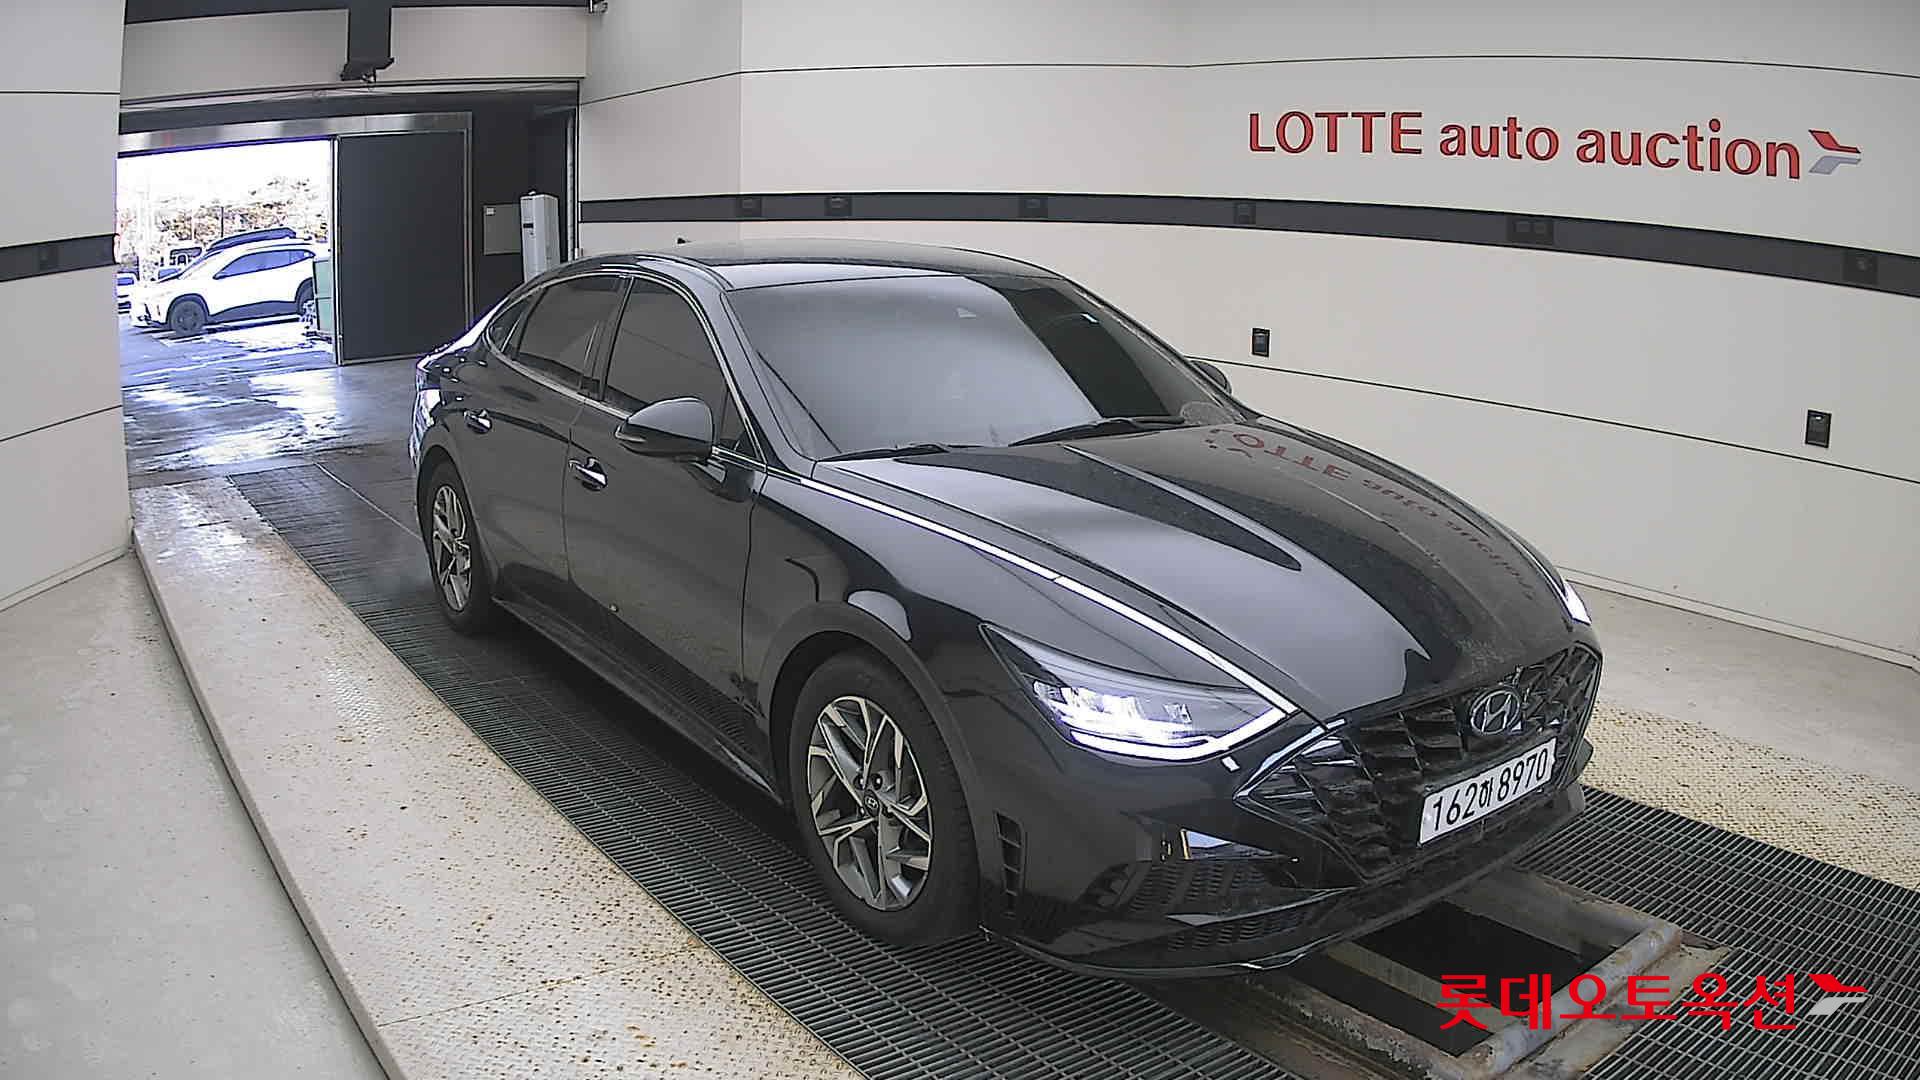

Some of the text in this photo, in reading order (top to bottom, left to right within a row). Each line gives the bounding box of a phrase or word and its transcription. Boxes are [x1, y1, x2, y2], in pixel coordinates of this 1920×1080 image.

[1248, 112, 1801, 179] LOTTE auto auction
[1432, 748, 1548, 831] 162하 8970
